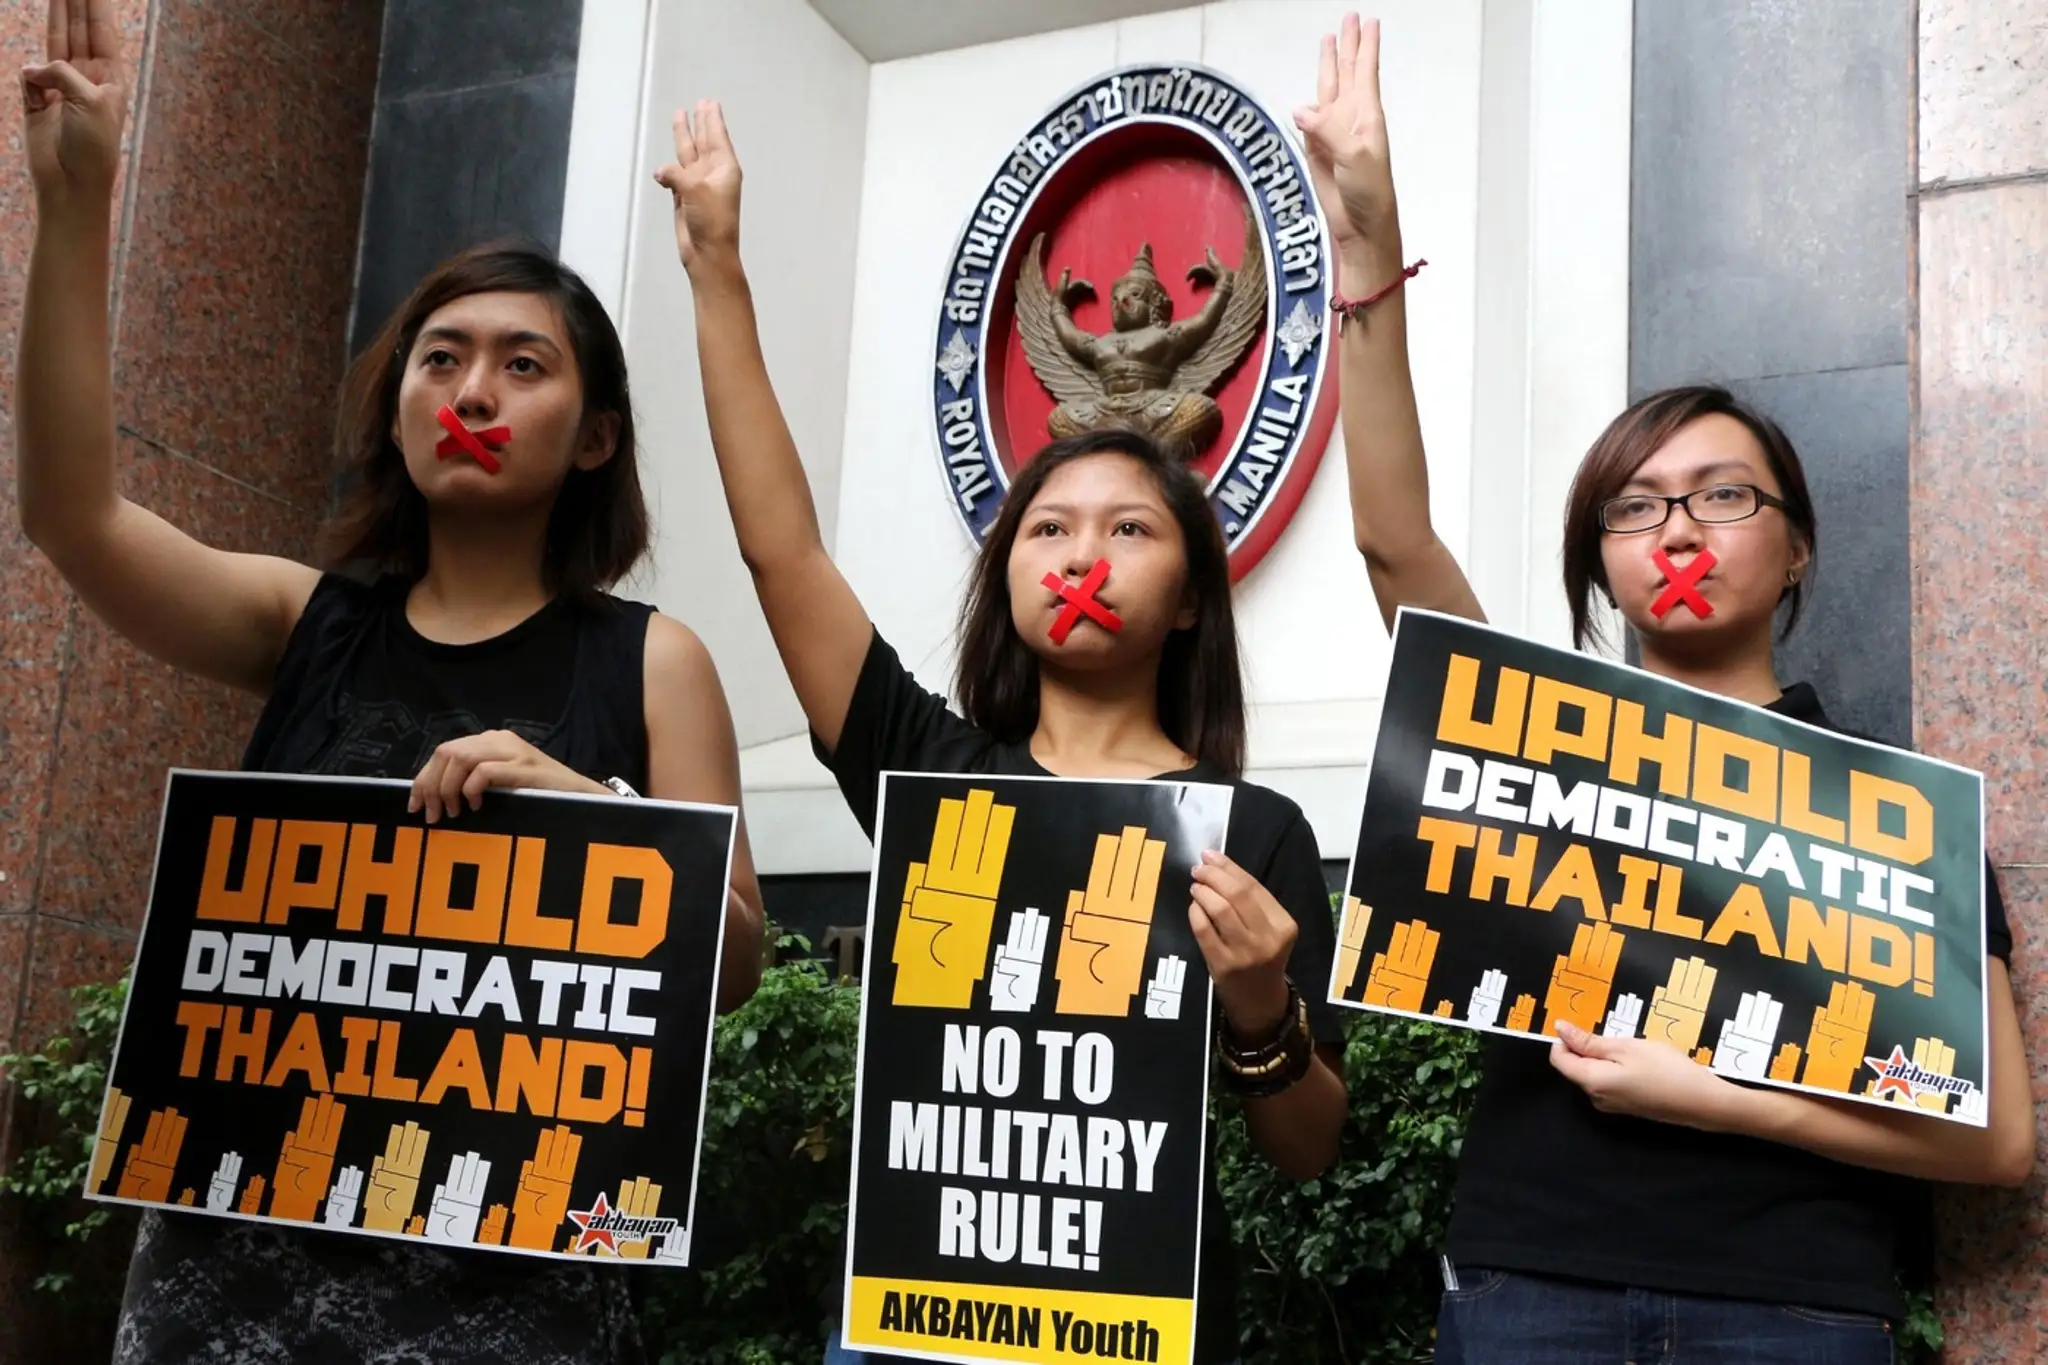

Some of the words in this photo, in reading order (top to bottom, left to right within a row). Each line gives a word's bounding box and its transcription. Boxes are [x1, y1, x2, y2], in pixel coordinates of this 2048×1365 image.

[942, 397, 992, 512] ROYAL
[1218, 374, 1308, 516] MANILA
[1436, 653, 1933, 866] UPHOLD
[196, 816, 674, 959] UPHOLD
[1422, 749, 1934, 926] DEMOCRATIC
[1417, 816, 1934, 997] THAILAND!
[181, 930, 662, 1035] DEMOCRATIC
[175, 1001, 653, 1128] THAILAND!
[941, 1023, 1022, 1098] NO
[1036, 1030, 1115, 1105] TO
[1885, 1061, 1972, 1094] akbayan
[888, 1100, 1169, 1192] MILITARY
[588, 1210, 675, 1239] akbayan
[938, 1186, 1103, 1272] RULE!
[879, 1291, 1042, 1349] AKBAYAN
[1051, 1311, 1160, 1363] Youth
